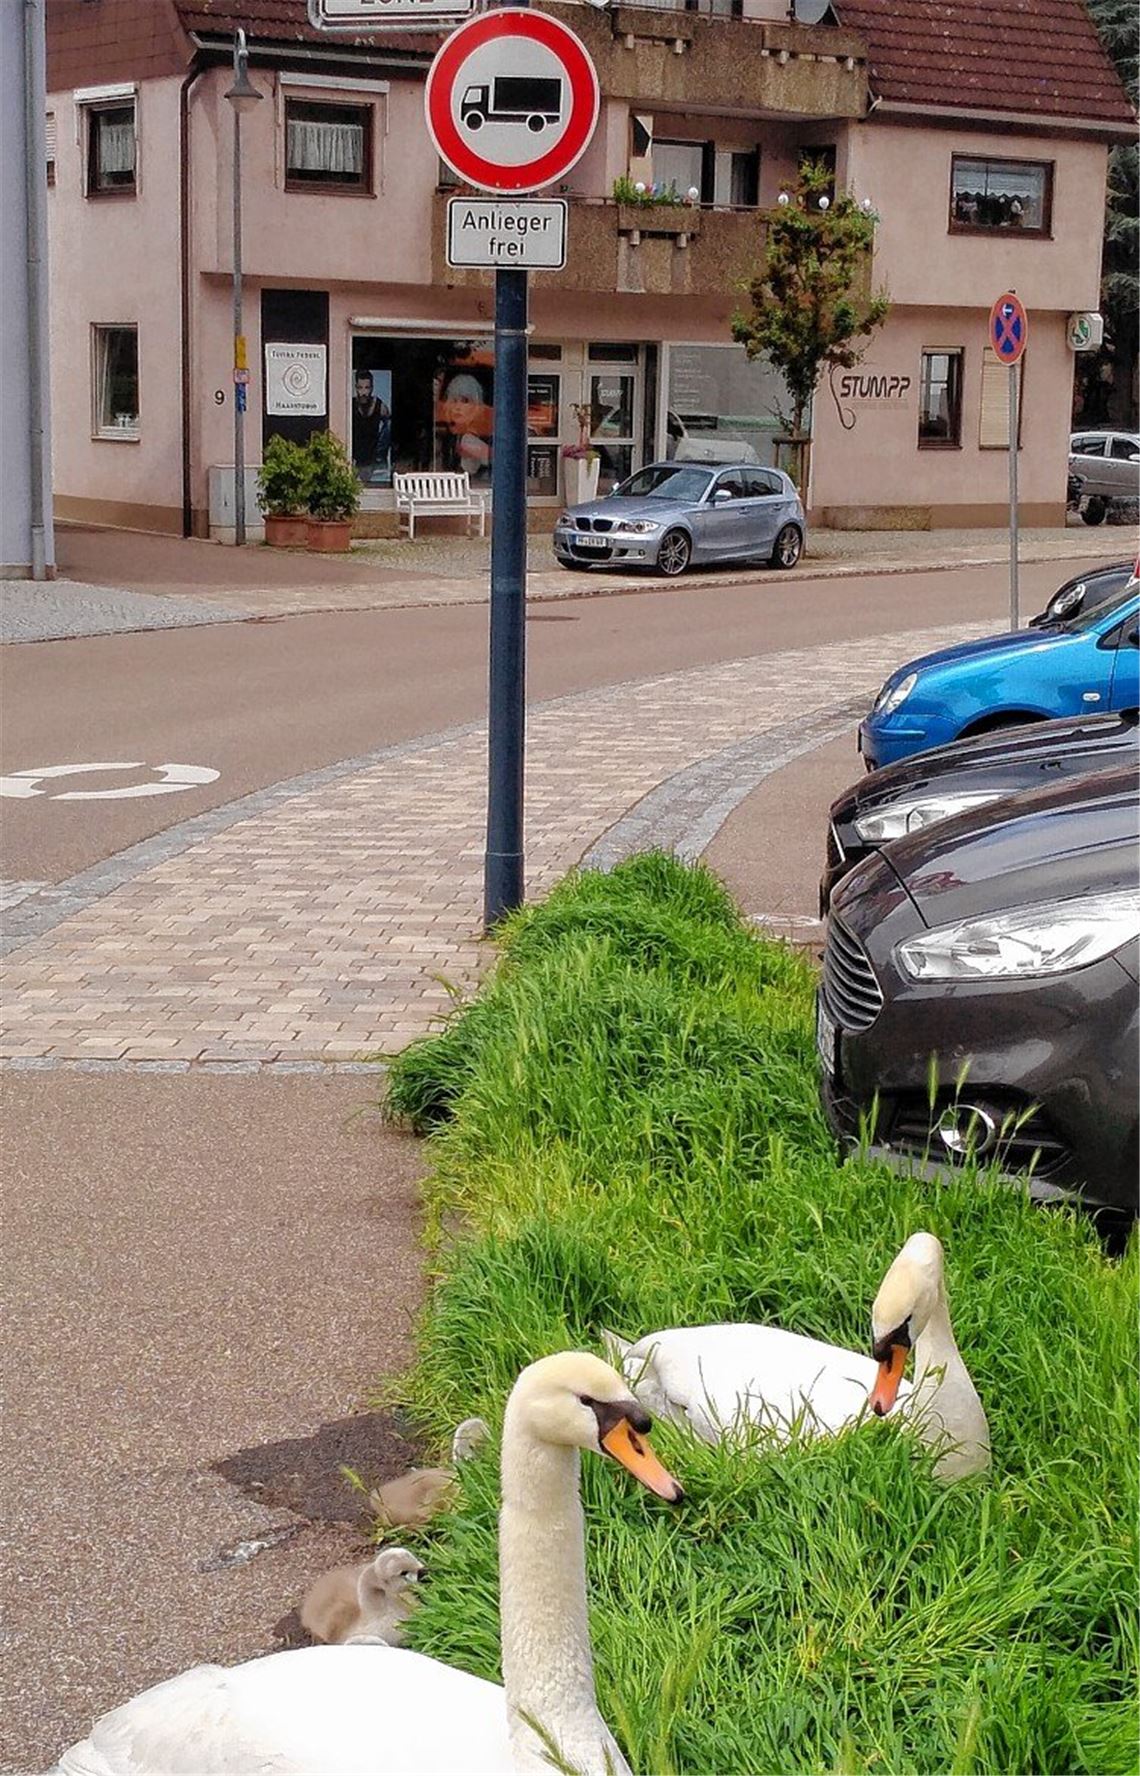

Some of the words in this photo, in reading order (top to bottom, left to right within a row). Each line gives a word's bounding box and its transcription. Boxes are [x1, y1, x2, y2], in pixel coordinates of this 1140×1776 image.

[462, 209, 552, 236] Anlieger
[488, 237, 525, 256] frei
[840, 375, 911, 398] STUMPP
[214, 390, 225, 405] 9
